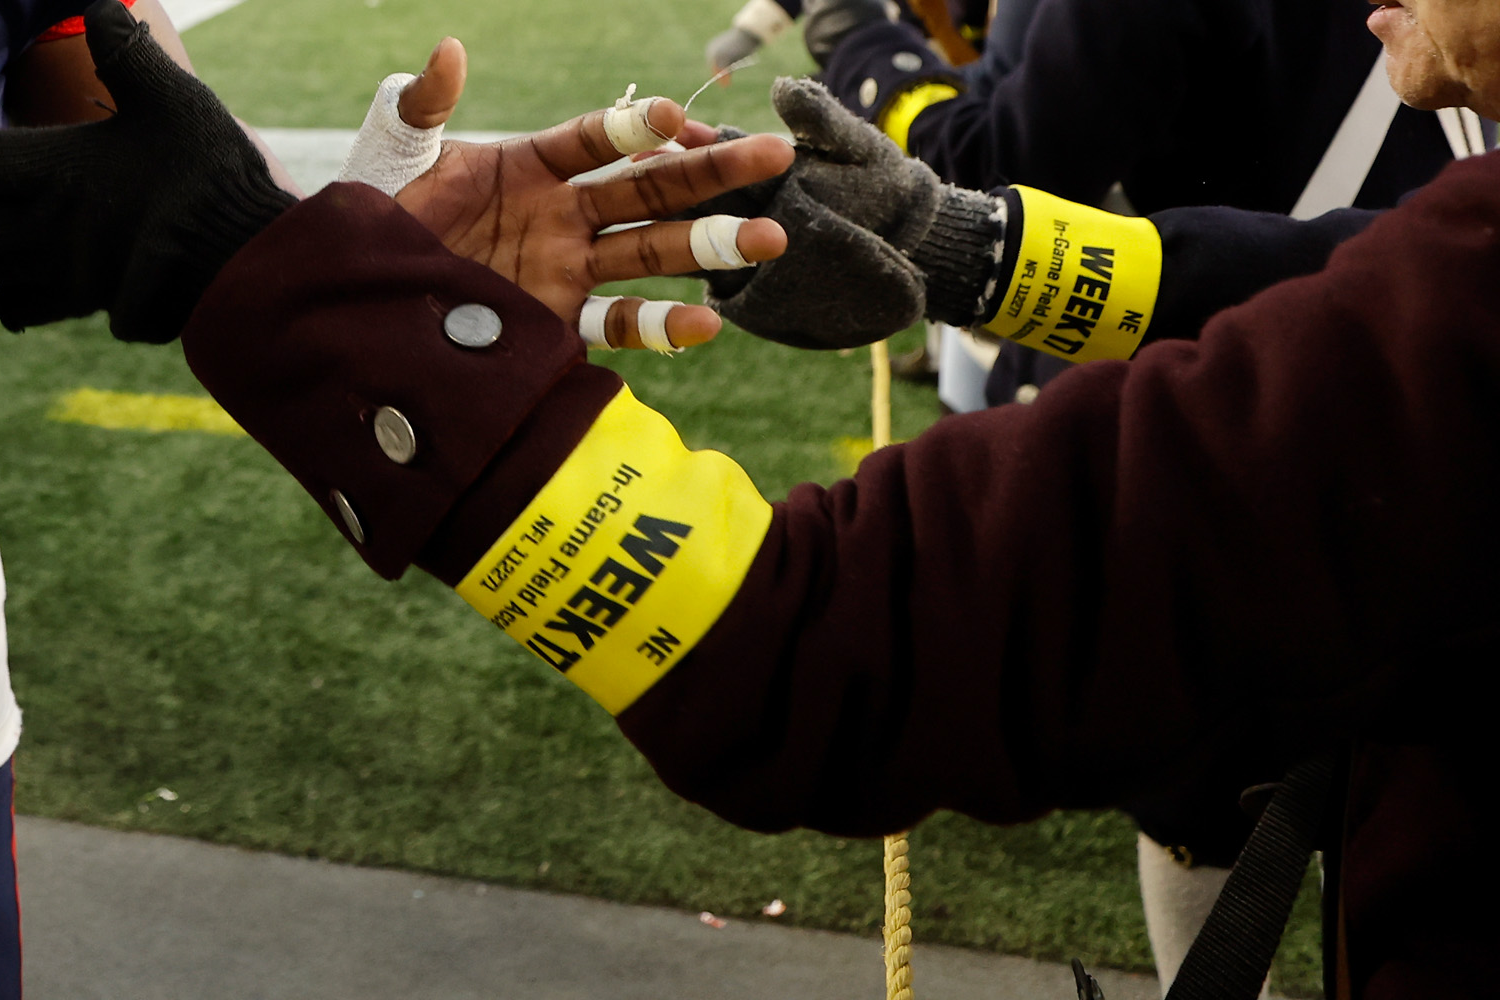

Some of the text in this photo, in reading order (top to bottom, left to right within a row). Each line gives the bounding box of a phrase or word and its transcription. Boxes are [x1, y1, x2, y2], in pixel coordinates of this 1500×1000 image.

[1021, 259, 1038, 280] NFL
[1032, 219, 1070, 318] In-Game Field
[1055, 245, 1115, 338] WEEK
[1117, 309, 1144, 335] NE
[520, 515, 556, 545] NFL
[560, 463, 643, 558] In-Game
[518, 557, 572, 608] Field
[545, 513, 694, 651] WEEK
[636, 626, 683, 667] NE
